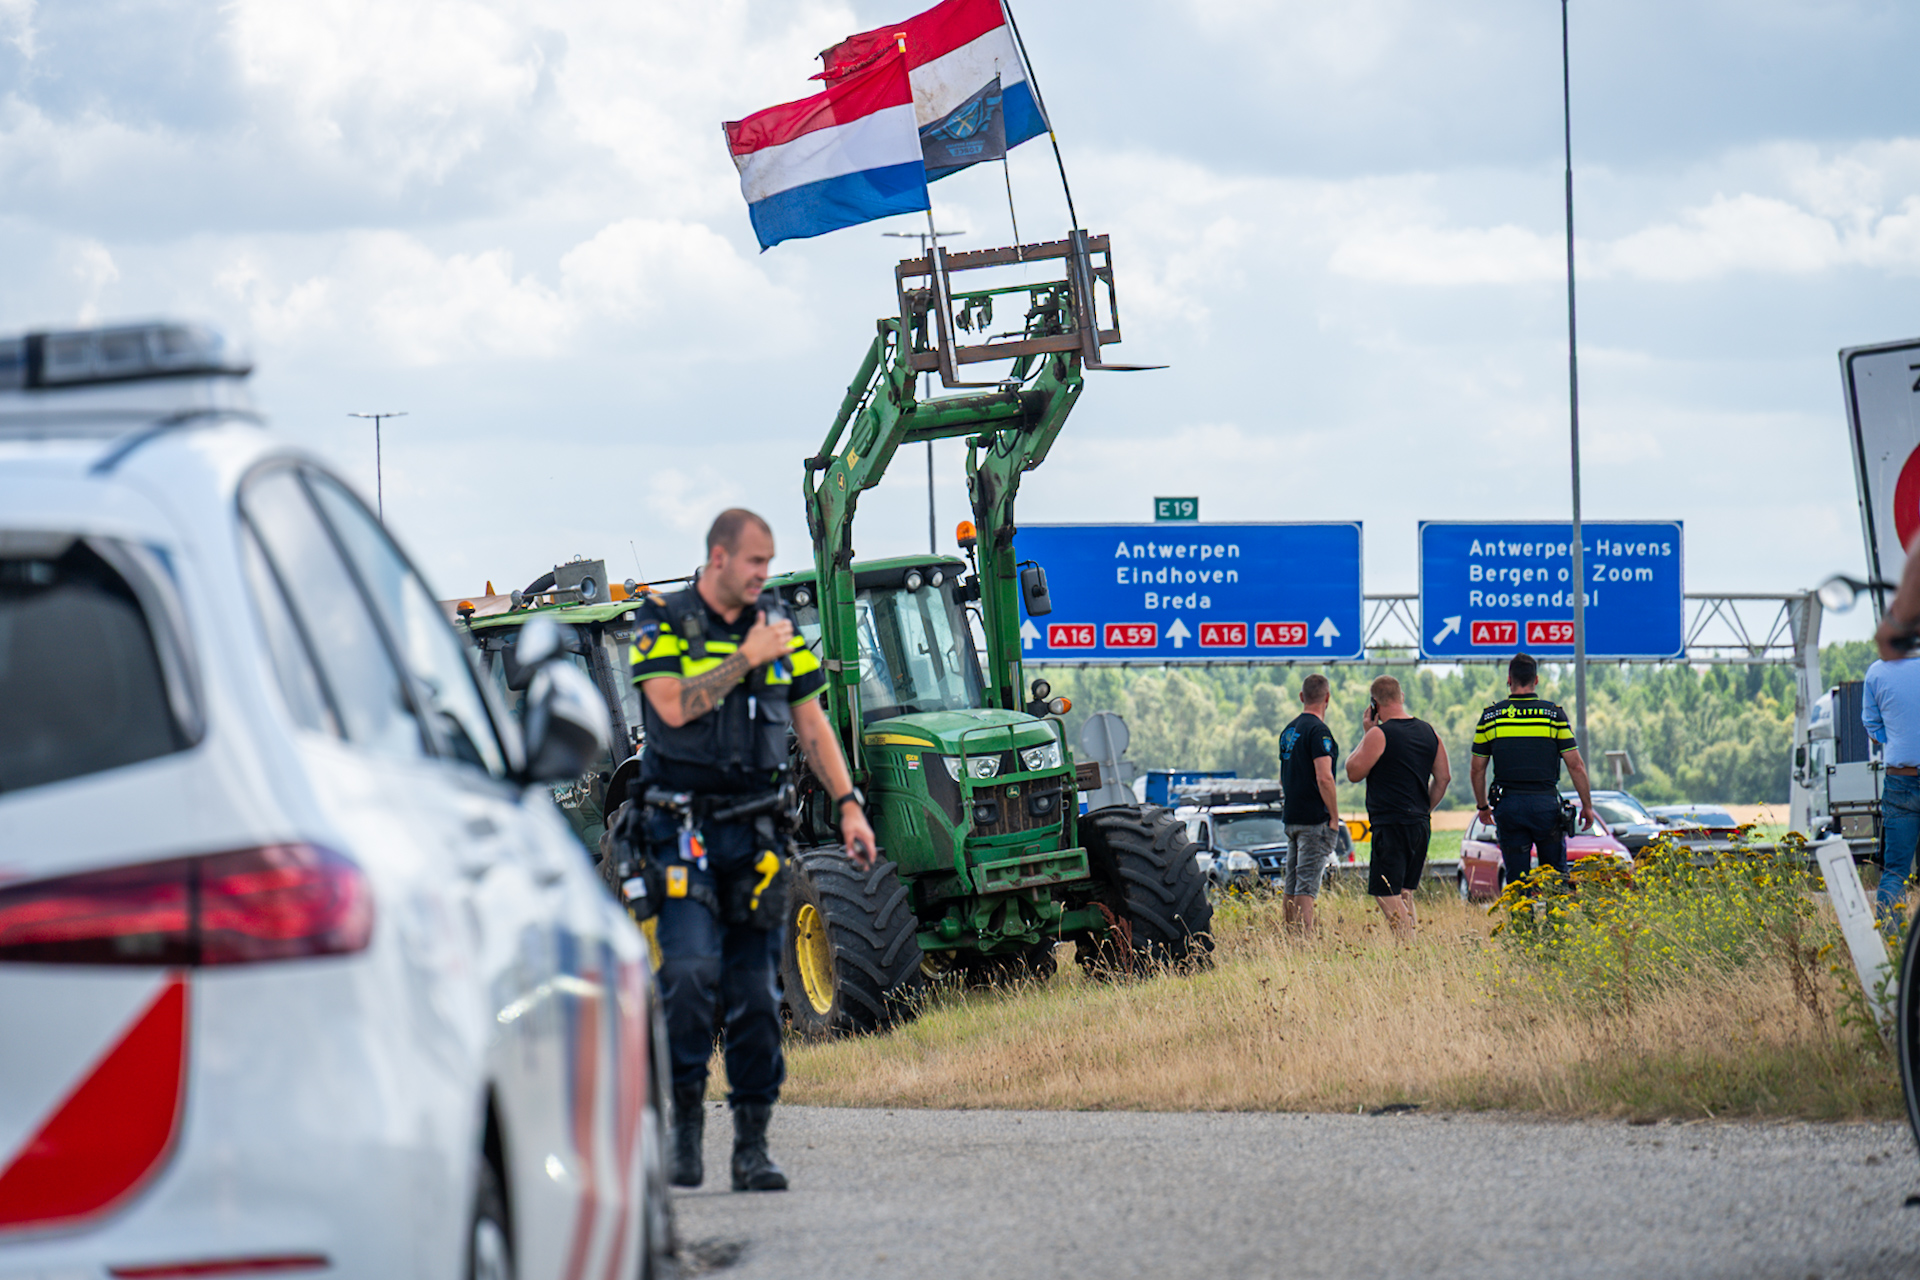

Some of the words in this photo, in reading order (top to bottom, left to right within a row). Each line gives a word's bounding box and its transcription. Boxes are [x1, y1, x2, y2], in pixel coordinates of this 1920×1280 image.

[1115, 541, 1240, 561] Antwerpen
[1116, 566, 1239, 585] Eindhoven
[1469, 564, 1549, 587] Bergen
[1592, 564, 1653, 582] Zoom
[1144, 591, 1211, 610] Breda
[1053, 628, 1092, 644] A16
[1109, 627, 1153, 644] A59
[1204, 627, 1243, 643] A16
[1261, 626, 1304, 643] A59
[1476, 625, 1513, 641] A17
[1531, 624, 1574, 641] A59
